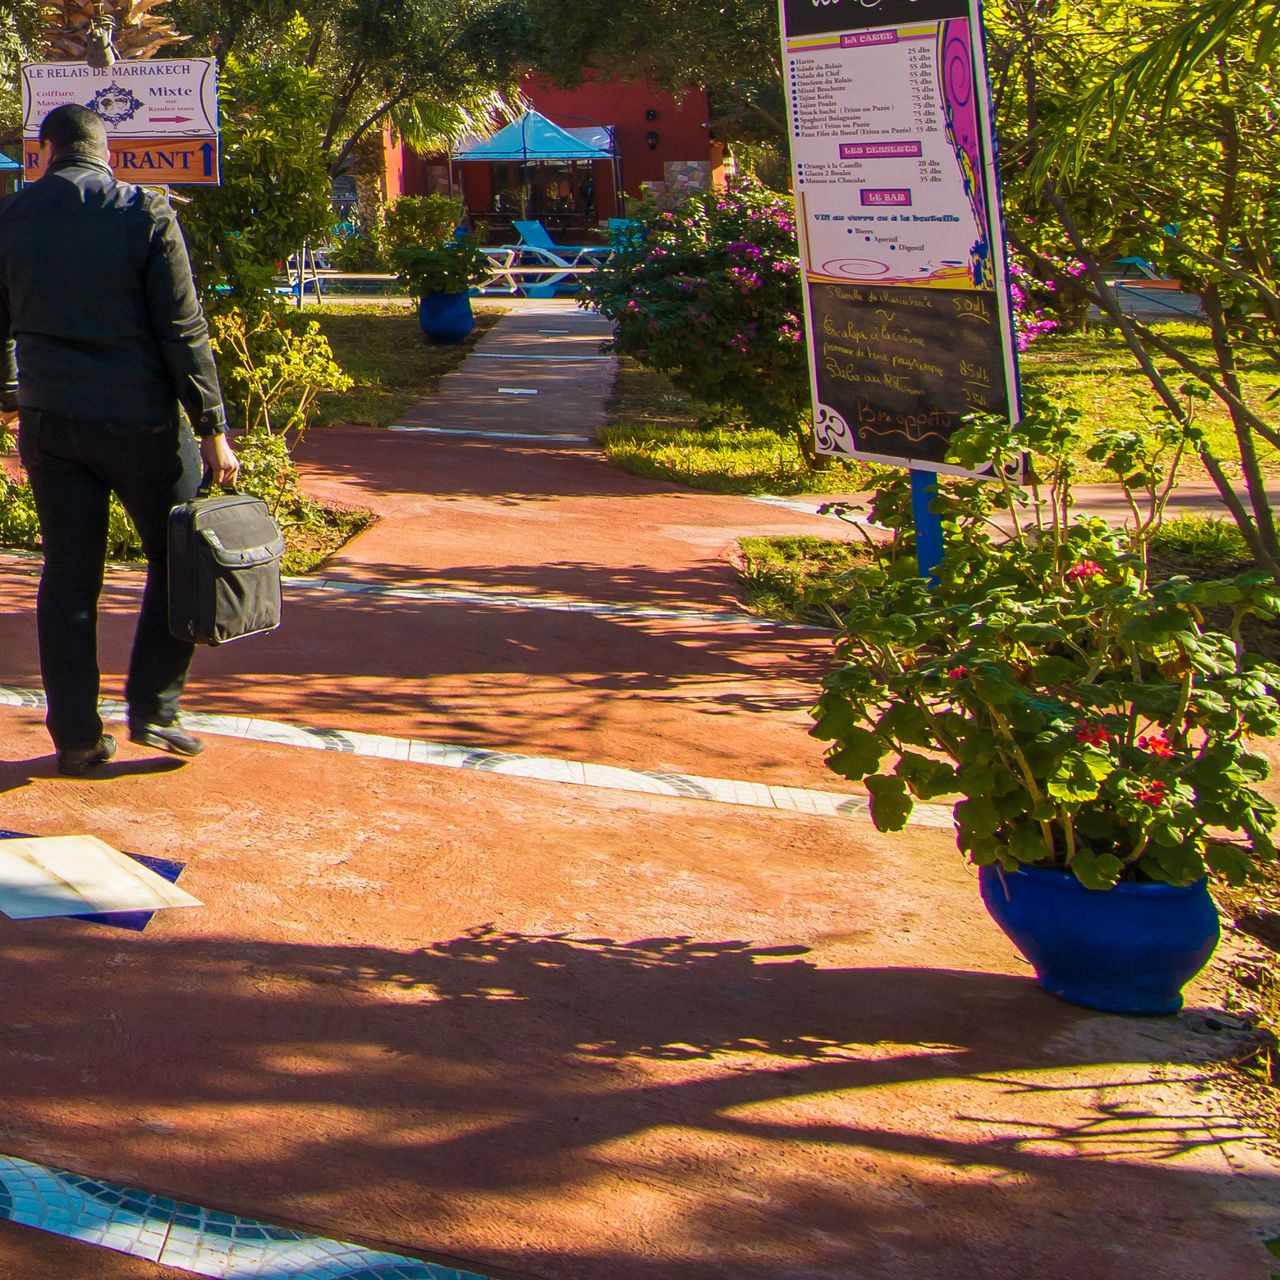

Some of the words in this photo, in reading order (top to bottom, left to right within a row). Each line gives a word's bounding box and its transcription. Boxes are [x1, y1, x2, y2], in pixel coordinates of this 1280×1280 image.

[844, 36, 858, 44] LA
[860, 32, 894, 43] CARTE
[29, 69, 44, 79] LE
[47, 67, 89, 78] RELAIS
[93, 68, 109, 77] DE
[112, 65, 191, 77] MARRAKECH
[149, 87, 193, 97] Mixte
[844, 147, 864, 155] LES
[866, 145, 918, 154] DESSERTS
[884, 193, 906, 201] BAR
[900, 214, 910, 222] la
[913, 214, 960, 222] bouteille
